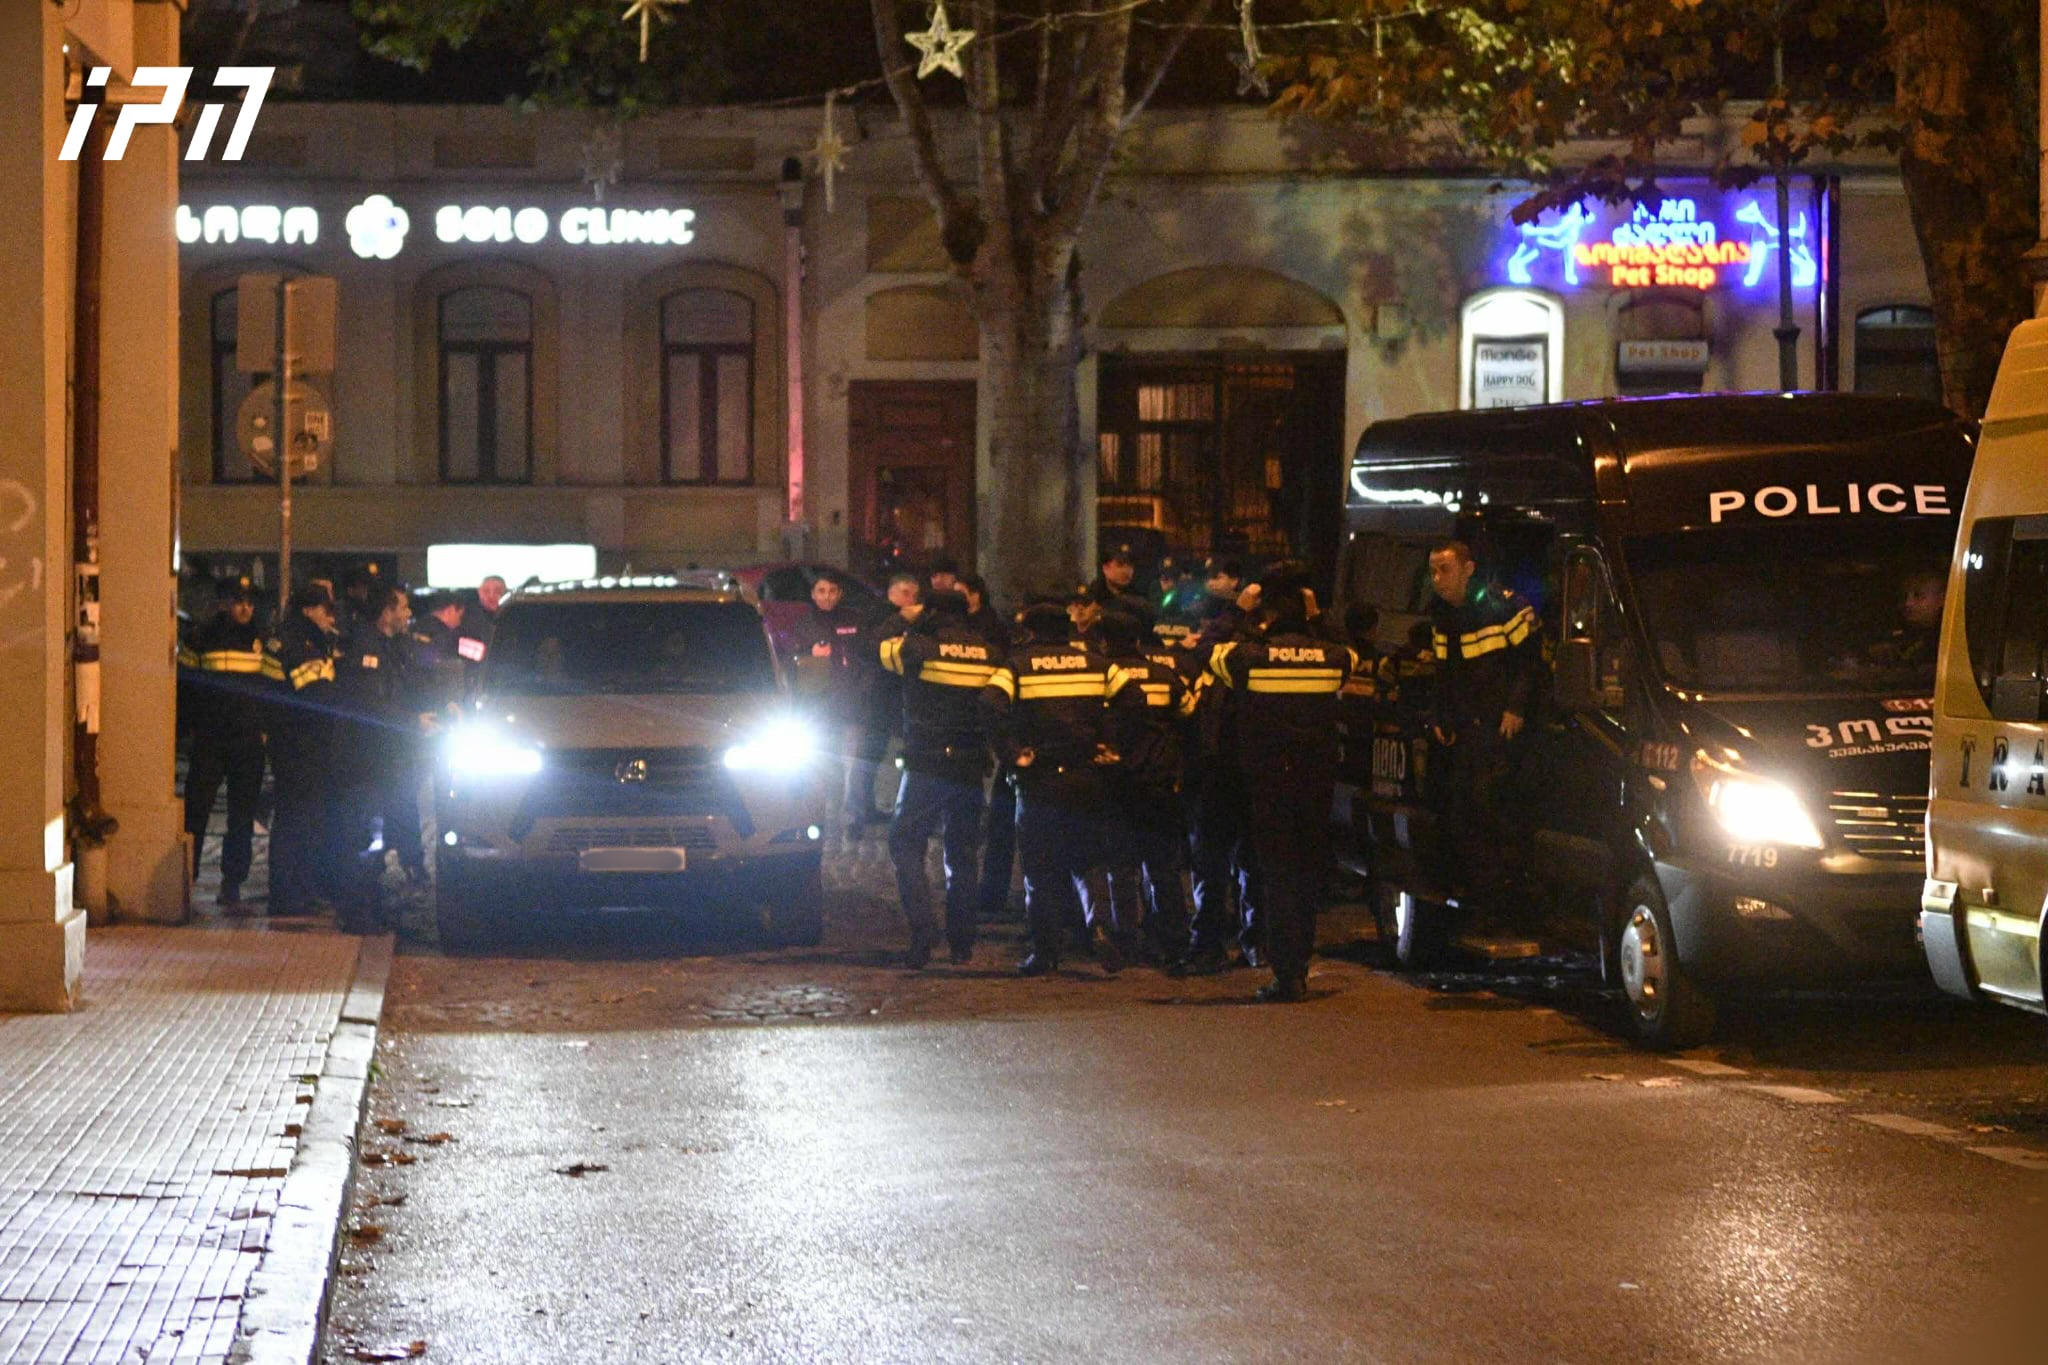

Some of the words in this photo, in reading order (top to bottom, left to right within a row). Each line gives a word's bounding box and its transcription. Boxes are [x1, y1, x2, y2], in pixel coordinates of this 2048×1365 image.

[436, 205, 549, 244] SOLO
[560, 207, 695, 244] CLINIC
[1612, 266, 1650, 286] Pet
[1655, 264, 1717, 288] Shop
[1483, 373, 1513, 388] HAPPY
[1516, 372, 1536, 386] DOG
[1710, 483, 1951, 523] POLICE
[939, 643, 988, 660] POLICE
[1268, 648, 1326, 662] POLICE
[1031, 656, 1087, 671] POLICE
[1728, 843, 1777, 868] 7719
